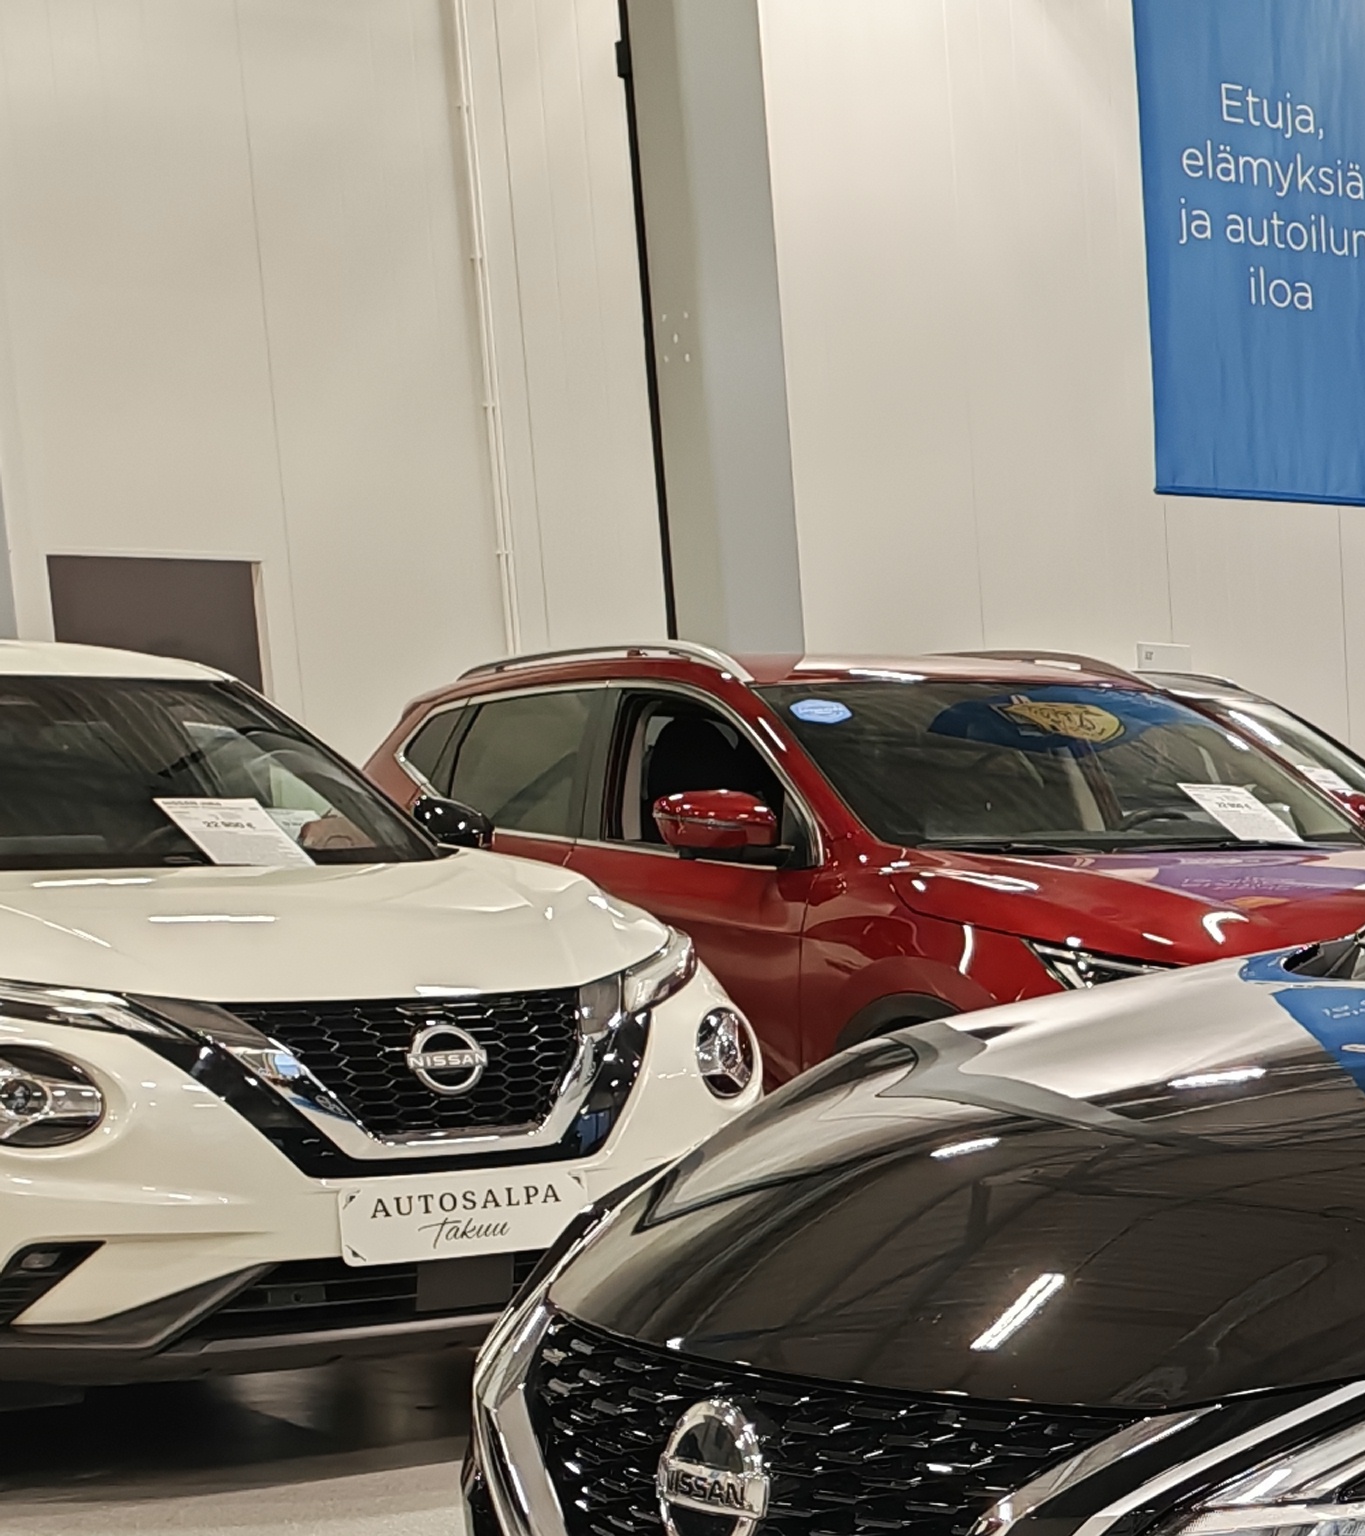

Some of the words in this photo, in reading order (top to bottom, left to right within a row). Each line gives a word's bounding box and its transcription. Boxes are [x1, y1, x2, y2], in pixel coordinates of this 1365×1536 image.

[1220, 82, 1324, 140] Etuja,
[1181, 139, 1364, 200] elämyksiä
[1179, 197, 1211, 244] ja
[1250, 265, 1313, 310] iloa
[408, 1051, 487, 1069] NISSAN
[370, 1183, 562, 1219] AUTOSALPA
[418, 1217, 511, 1249] Takuu
